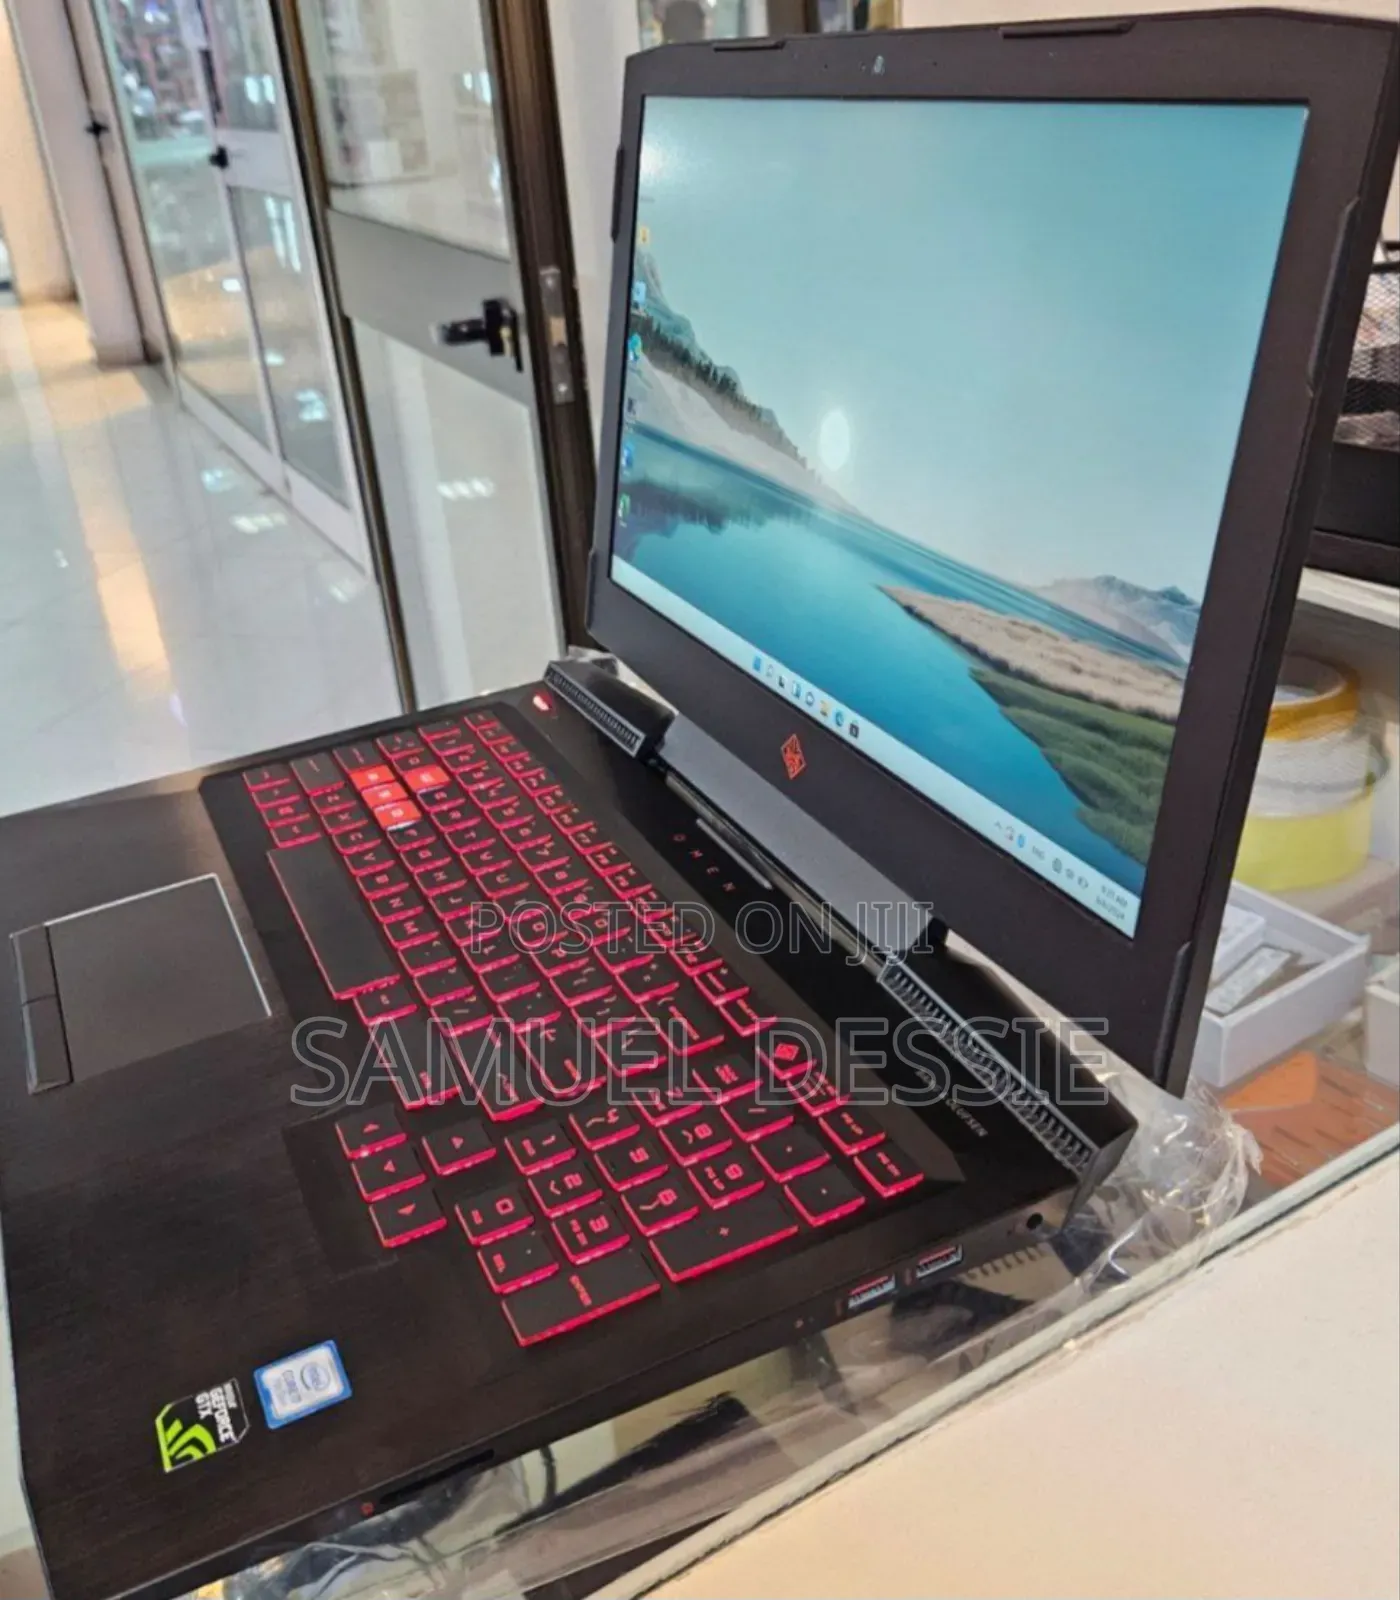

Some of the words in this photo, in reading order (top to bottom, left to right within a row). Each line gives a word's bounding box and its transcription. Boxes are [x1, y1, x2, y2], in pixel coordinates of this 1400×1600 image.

[607, 1108, 618, 1123] 4
[694, 1123, 712, 1138] 8
[629, 1147, 648, 1162] 5
[724, 1163, 742, 1179] 9
[563, 1173, 582, 1188] 2
[658, 1189, 676, 1204] 6
[495, 1198, 513, 1214] 0
[589, 1215, 608, 1232] 3
[195, 1391, 213, 1421] GTX
